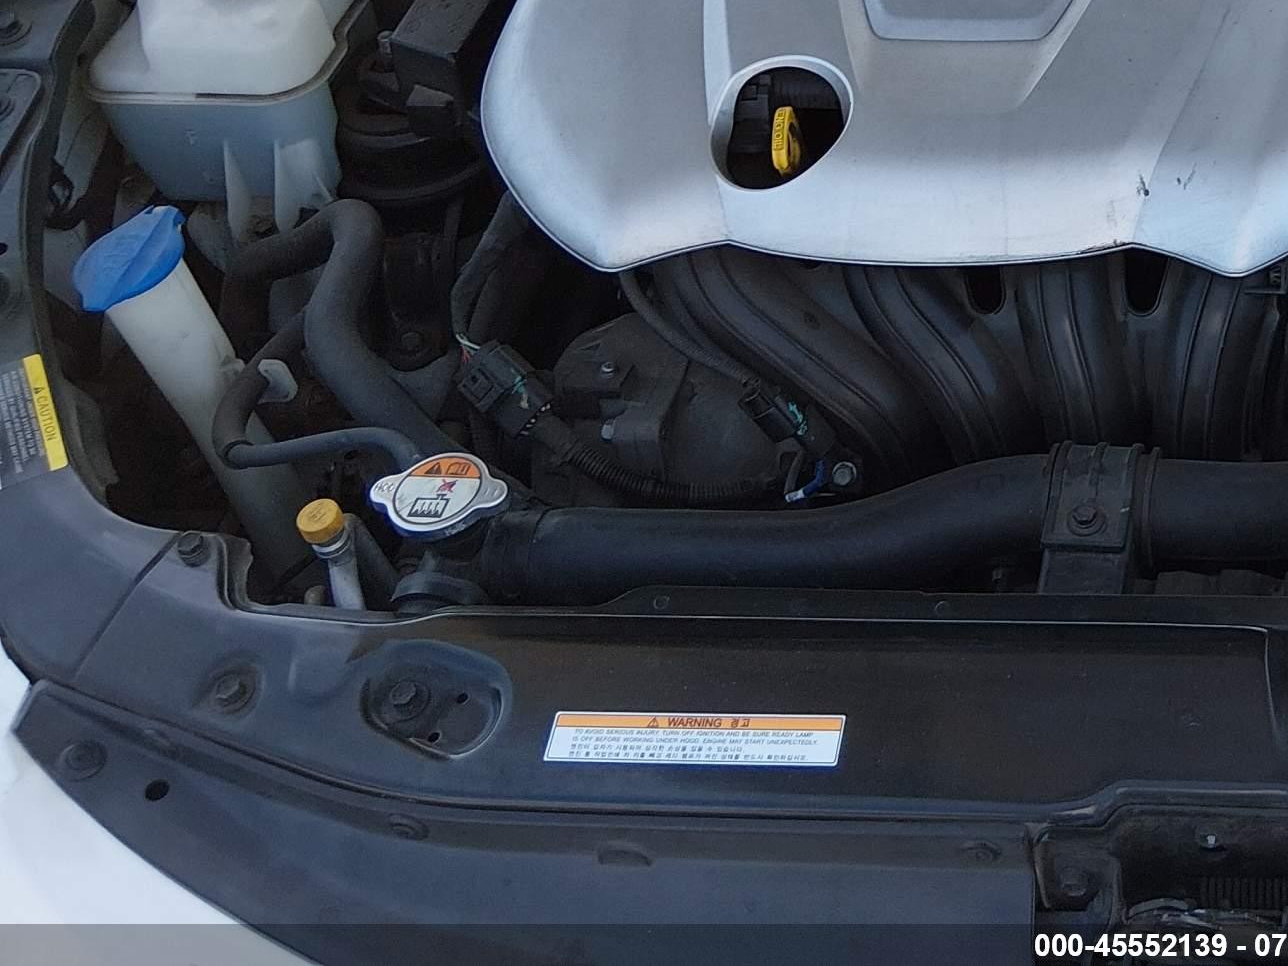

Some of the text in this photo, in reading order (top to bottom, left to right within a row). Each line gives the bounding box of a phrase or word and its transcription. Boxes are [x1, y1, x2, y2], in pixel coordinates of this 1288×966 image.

[36, 395, 58, 442] CAUTION
[667, 717, 722, 728] WARNING
[730, 718, 751, 728] 경고
